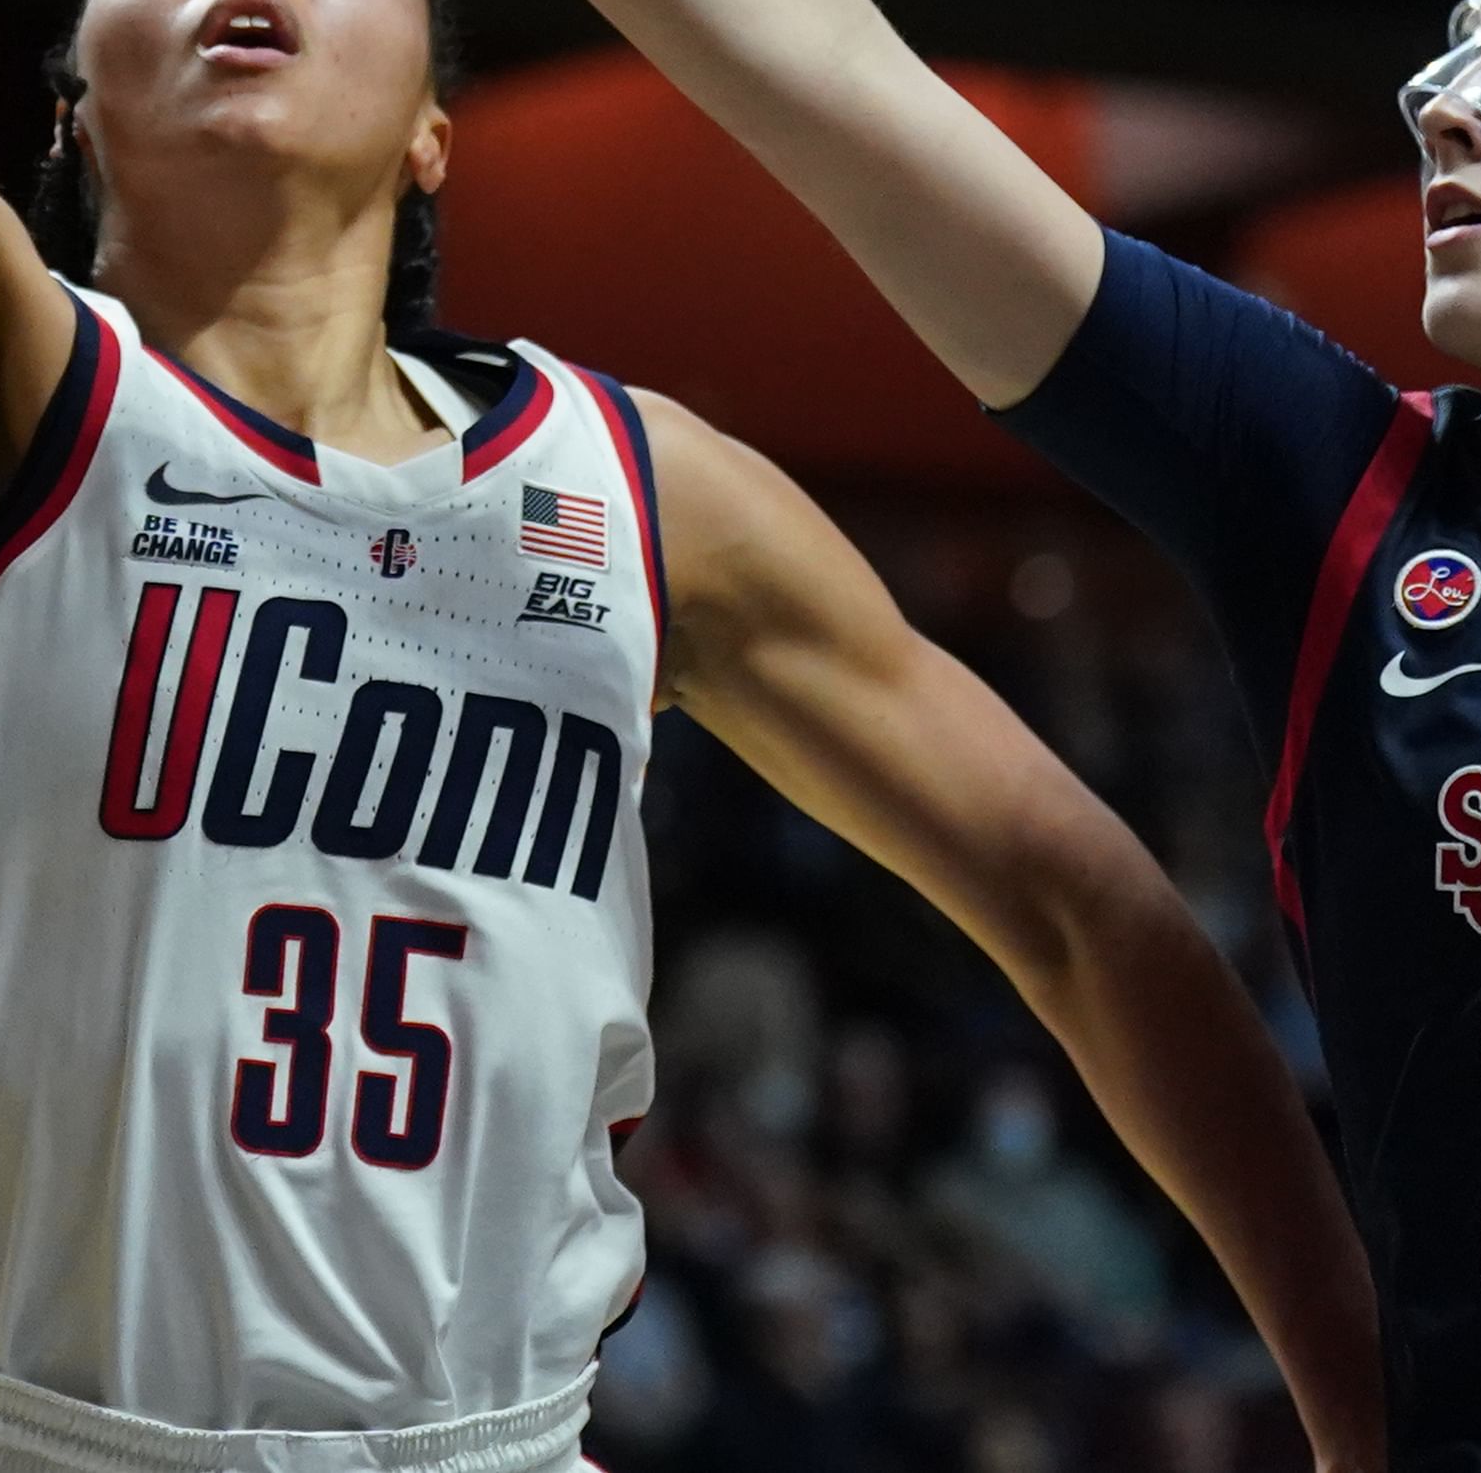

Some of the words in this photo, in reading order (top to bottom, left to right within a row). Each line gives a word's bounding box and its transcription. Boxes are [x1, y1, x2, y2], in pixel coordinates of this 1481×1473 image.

[144, 514, 178, 534] BE
[188, 521, 234, 542] THE
[131, 532, 239, 565] CHANGE
[534, 572, 595, 599] BIG
[524, 592, 611, 624] EAST
[98, 581, 622, 903] UConn
[231, 903, 469, 1171] 35
